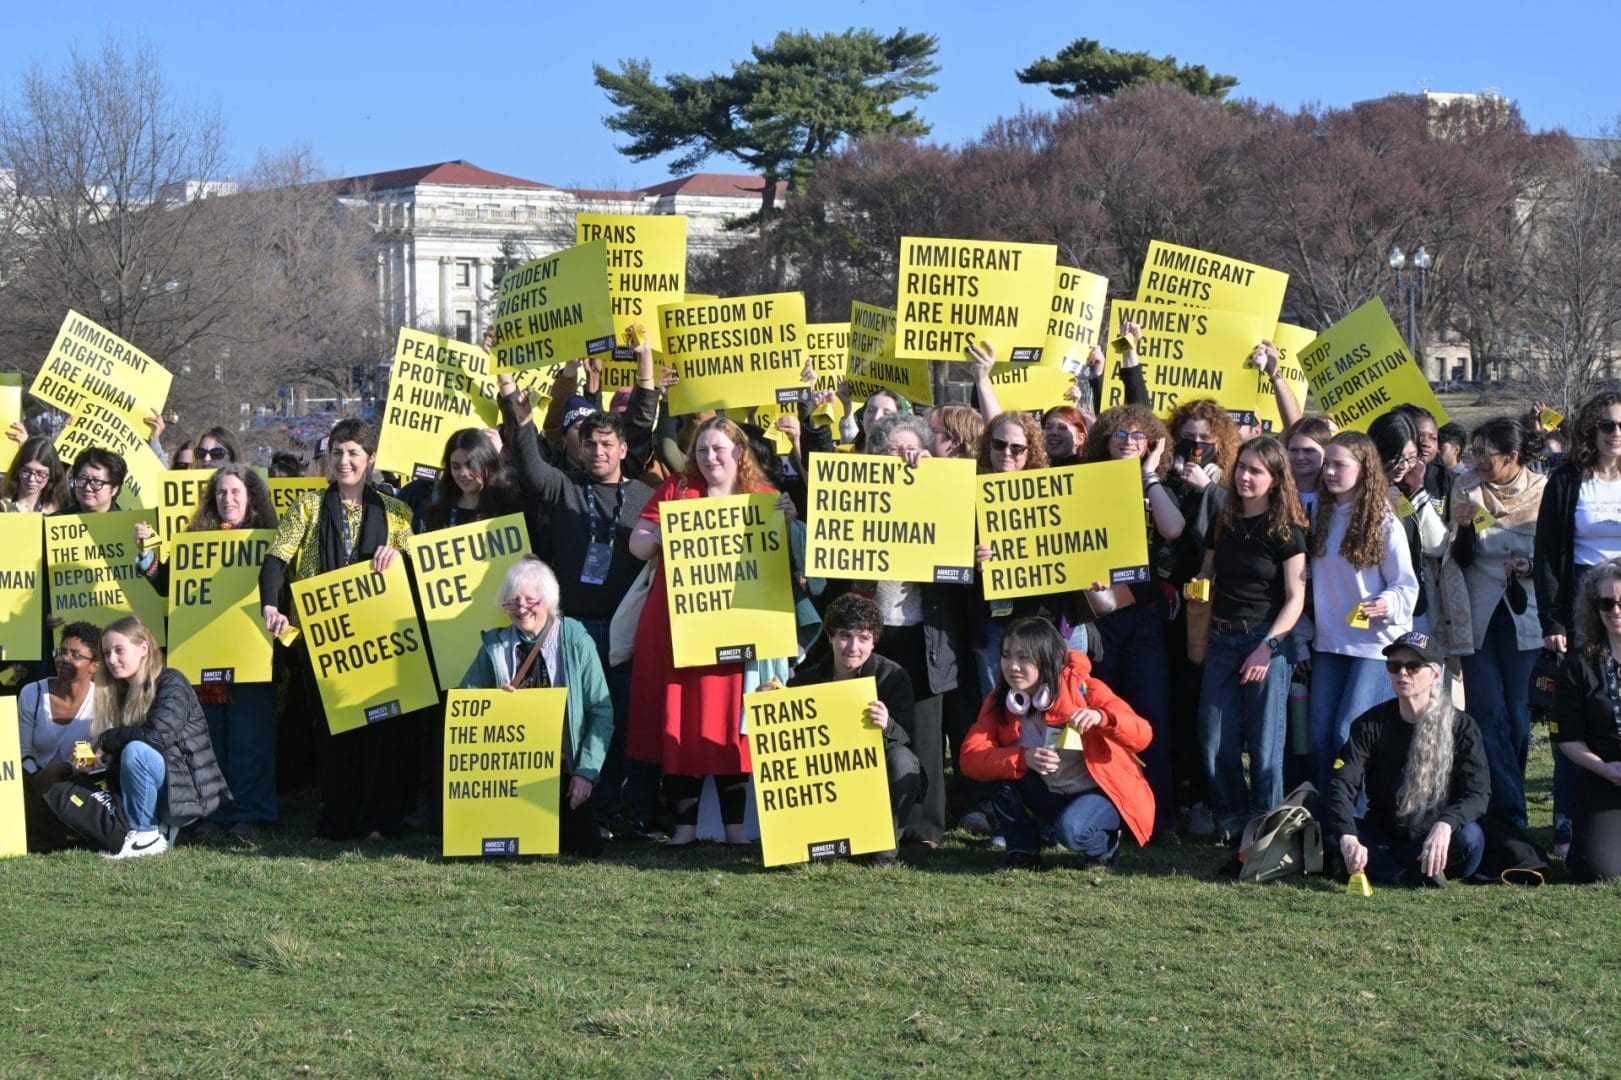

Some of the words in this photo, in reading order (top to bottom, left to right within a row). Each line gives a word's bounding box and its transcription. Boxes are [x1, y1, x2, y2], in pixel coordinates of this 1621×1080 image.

[582, 224, 636, 244] TRANS
[909, 244, 1022, 271] IMMIGRANT
[1154, 247, 1255, 286] IMMIGRANT
[502, 258, 560, 296] STUDENT
[620, 273, 678, 292] HUMAN
[907, 273, 979, 297] RIGHTS
[1059, 272, 1081, 291] OF
[1147, 271, 1212, 301] RIGHTS
[497, 286, 547, 318] RIGHTS
[664, 303, 746, 329] FREEDOM
[752, 300, 774, 320] OF
[904, 301, 943, 324] ARE
[951, 303, 1018, 328] HUMAN
[1080, 301, 1094, 320] IS
[496, 318, 524, 344] ARE
[528, 303, 583, 335] HUMAN
[1047, 318, 1094, 344] RIGHT
[1118, 306, 1208, 336] WOMEN'S
[68, 318, 150, 374] IMMIGRANT
[497, 338, 554, 368] RIGHTS
[667, 325, 773, 356] EXPRESSION
[780, 323, 796, 343] IS
[904, 330, 976, 352] RIGHTS
[59, 337, 114, 377] RIGHTS
[402, 338, 488, 376] PEACEFUL
[672, 362, 680, 378] A
[684, 354, 743, 378] HUMAN
[750, 348, 802, 371] RIGHT
[1304, 342, 1332, 372] STOP
[1311, 367, 1335, 392] THE
[1334, 344, 1371, 374] MASS
[48, 357, 82, 384] ARE
[82, 374, 136, 412] HUMAN
[398, 360, 474, 393] PROTEST
[480, 380, 496, 400] IS
[600, 368, 637, 386] IGHT
[870, 361, 910, 386] HUMAN
[1156, 365, 1223, 390] HUMAN
[1320, 348, 1408, 411] DEPORTATION
[38, 376, 87, 410] RIGHT
[393, 384, 404, 402] A
[410, 387, 472, 416] HUMAN
[1329, 386, 1391, 429] MACHINE
[83, 402, 144, 452] STUDENT
[389, 406, 444, 434] RIGHT
[74, 417, 128, 457] RIGHTS
[816, 460, 915, 485] WOMEN'S
[816, 489, 892, 514] RIGHTS
[983, 473, 1074, 504] STUDENT
[50, 524, 88, 540] STOP
[667, 505, 766, 534] PEACEFUL
[814, 518, 854, 541] ARE
[862, 520, 936, 544] HUMAN
[986, 504, 1062, 532] RIGHTS
[52, 546, 79, 563] THE
[85, 542, 124, 560] MASS
[176, 540, 270, 570] DEFUND
[417, 525, 523, 574] DEFUND
[669, 532, 754, 560] PROTEST
[762, 530, 780, 552] IS
[814, 547, 890, 572] RIGHTS
[989, 537, 1028, 562] ARE
[1036, 527, 1108, 557] HUMAN
[54, 564, 143, 586] DEPORTATI
[672, 567, 684, 588] A
[690, 560, 758, 586] HUMAN
[992, 562, 1066, 591] RIGHTS
[56, 588, 124, 610] MACHINE
[175, 578, 212, 606] ICE
[301, 571, 387, 616] DEFEND
[424, 574, 472, 610] ICE
[674, 589, 732, 614] RIGHT
[310, 613, 355, 647] DUE
[318, 628, 419, 678] PROCESS
[450, 700, 492, 718] STOP
[751, 698, 817, 727] TRANS
[450, 726, 478, 744] THE
[484, 724, 526, 743] MASS
[756, 724, 830, 755] RIGHTS
[449, 751, 554, 772] DEPORTATION
[760, 758, 799, 784] ARE
[806, 746, 878, 777] HUMAN
[448, 780, 518, 800] MACHINE
[762, 780, 838, 812] RIGHTS
